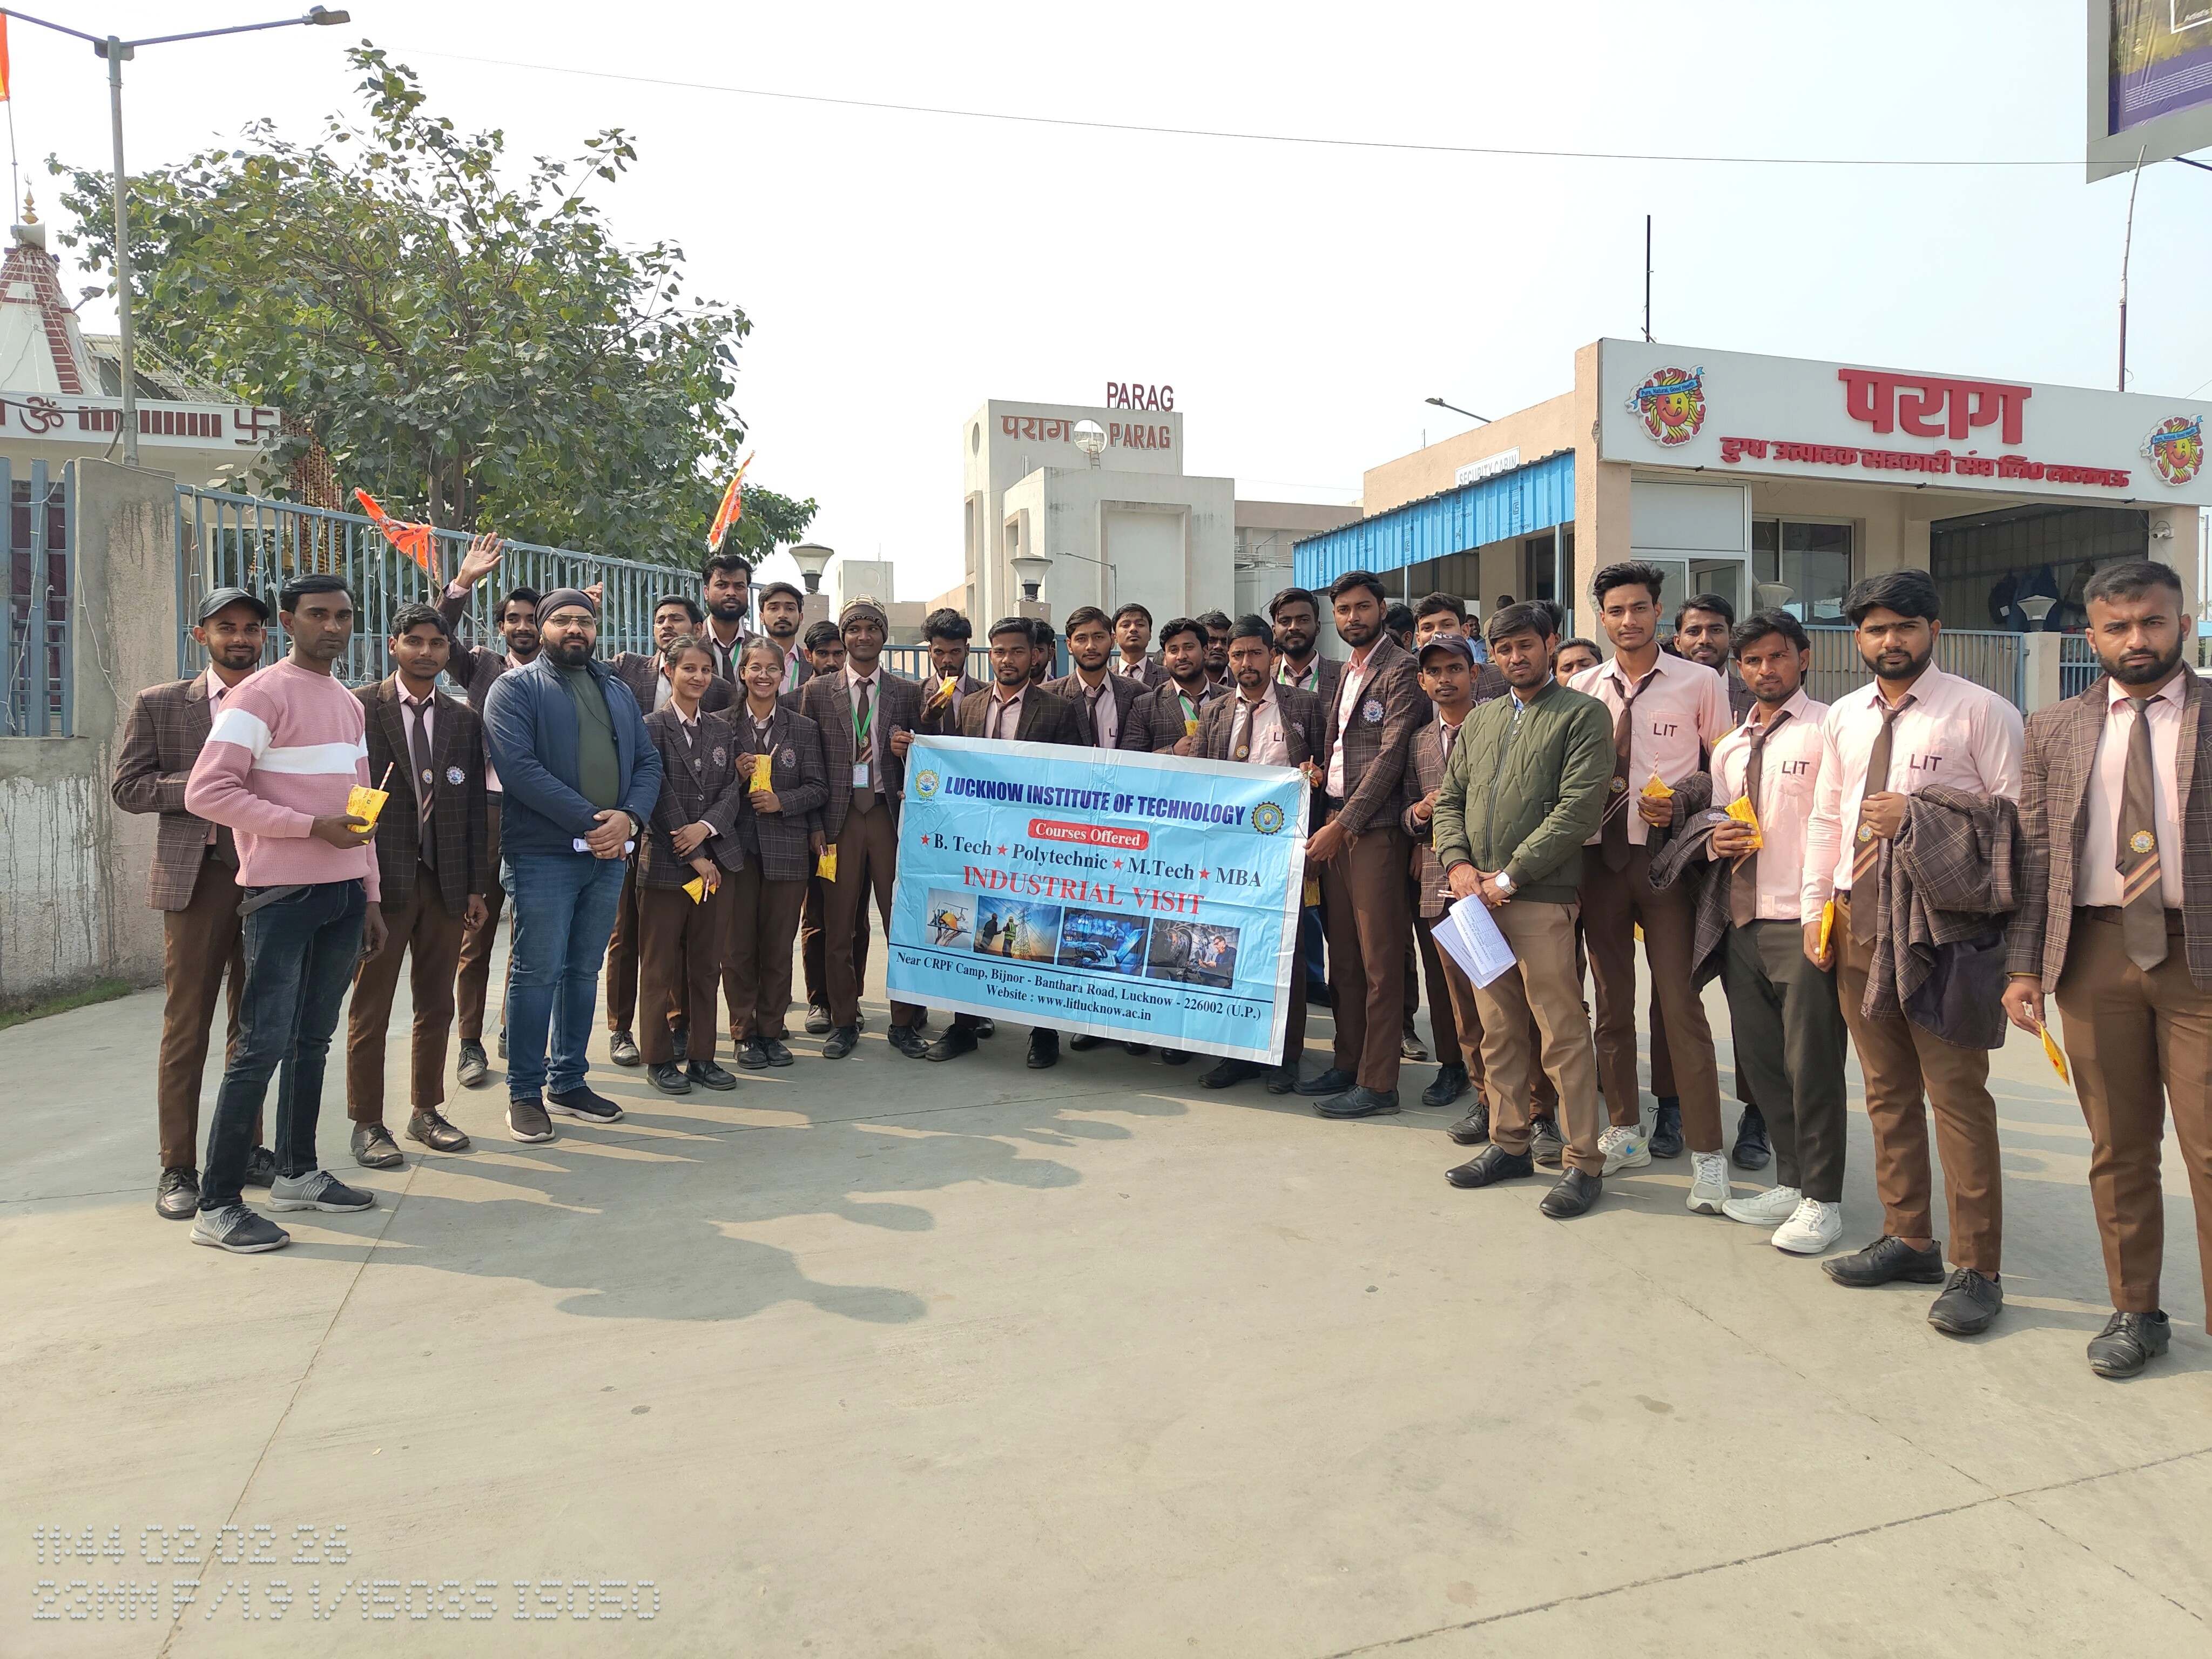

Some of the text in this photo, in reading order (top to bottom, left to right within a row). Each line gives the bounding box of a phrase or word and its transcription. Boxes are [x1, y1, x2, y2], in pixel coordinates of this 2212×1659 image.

[1107, 381, 1174, 412] PARAG
[1682, 381, 1695, 390] Health
[1838, 368, 2032, 444] पराग
[1001, 415, 1074, 443] पराग
[1109, 423, 1171, 449] PARAG
[1720, 437, 1770, 463] दुग्ध
[1770, 441, 1861, 466] उत्पादक
[1860, 449, 1954, 473] सहकारी
[1953, 450, 1998, 476] संघ
[2044, 464, 2132, 488] लखनऊ
[1432, 632, 1453, 642] NG
[1109, 728, 1117, 738] LI
[1273, 732, 1284, 741] LI
[1654, 723, 1678, 737] LIT
[1782, 760, 1810, 775] LIT
[1909, 754, 1943, 772] LIT
[945, 777, 1024, 802] LUCKNOW
[1027, 785, 1111, 811] INSTITUTE
[1113, 793, 1134, 813] OF
[1137, 796, 1246, 826] TECHNOLOGY
[934, 833, 992, 855] B. Tech
[1036, 822, 1141, 846] Courses Offered
[1011, 844, 1108, 869] Polytechnic
[1127, 857, 1195, 880] M.Tech
[1215, 867, 1262, 887] MBA
[963, 865, 1205, 915] INDUSTRIAL VISIT
[896, 952, 920, 966] Near
[923, 957, 954, 972] CRPF
[956, 962, 988, 980] Camp,
[991, 968, 1025, 983] Bijnor
[1034, 975, 1083, 994] Banthara
[1087, 983, 1118, 1001] Road,
[1121, 988, 1174, 1007] Lucknow
[1183, 997, 1224, 1014] 226002
[1226, 1004, 1262, 1020] (U.P.)
[986, 984, 1027, 1001] Website
[1037, 994, 1152, 1021] www.litlucknow.ac.in
